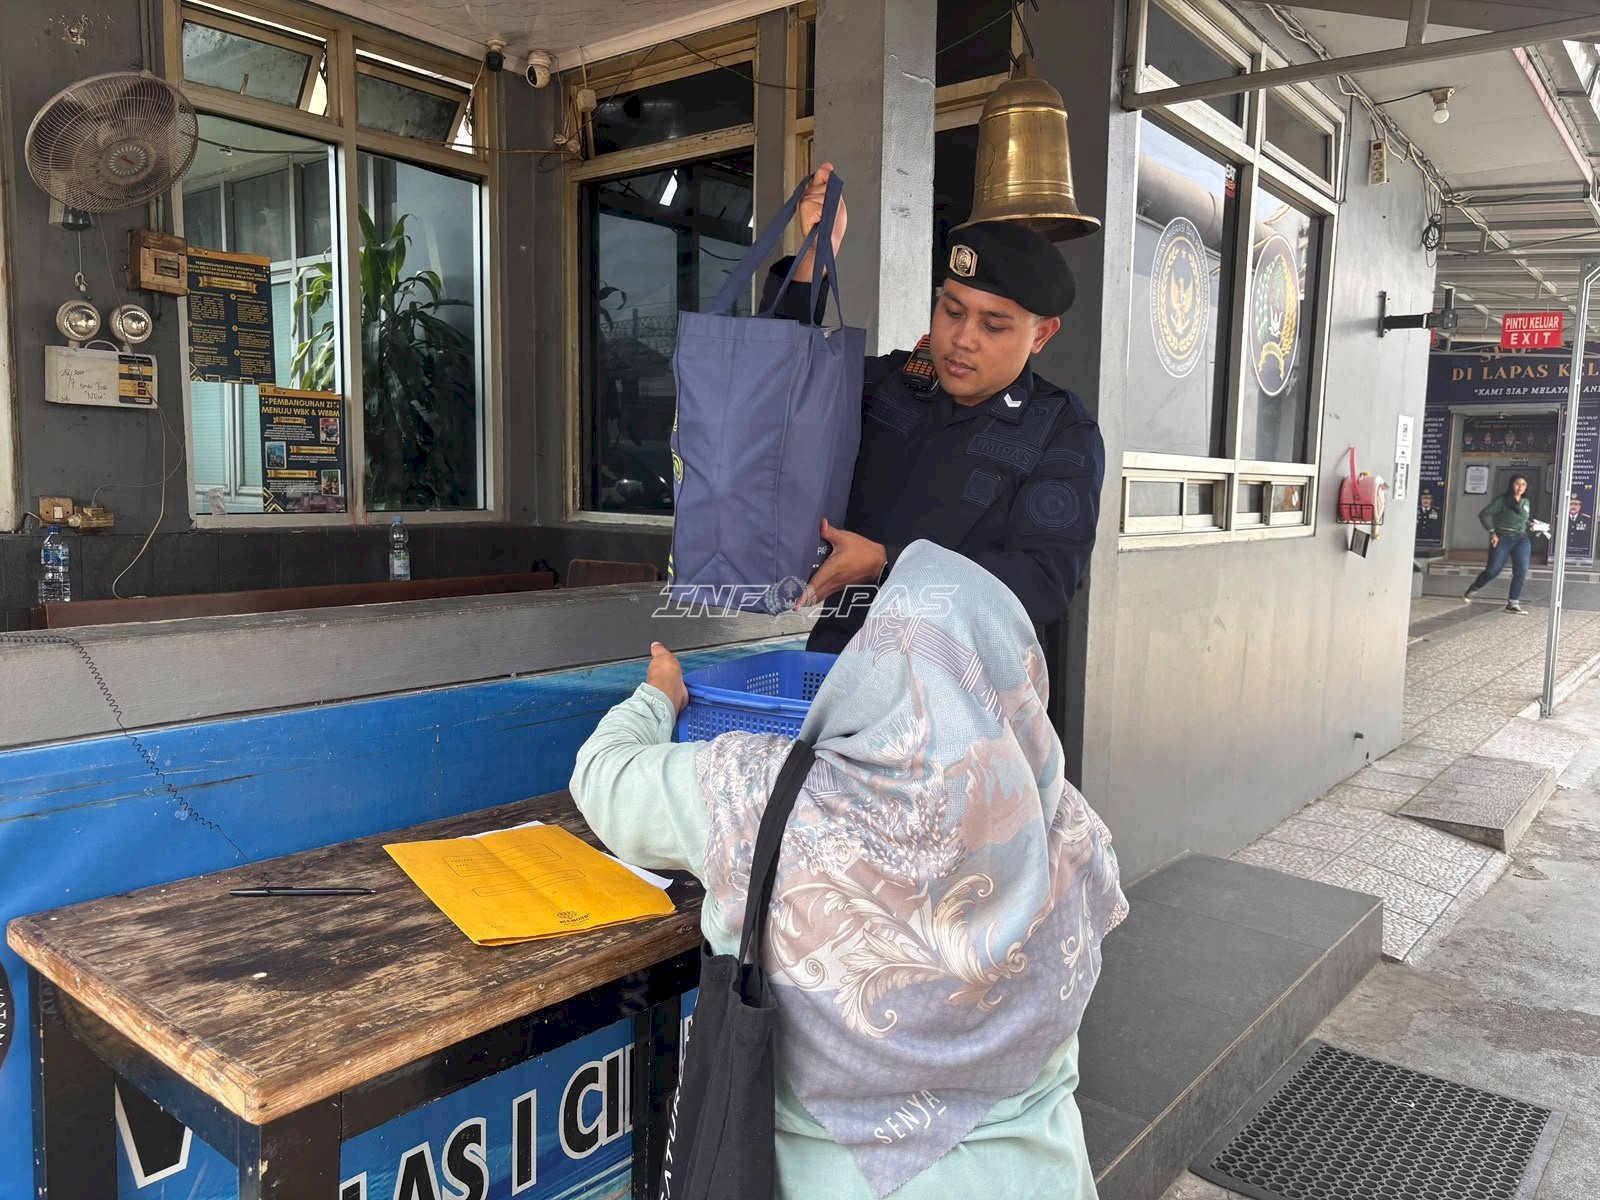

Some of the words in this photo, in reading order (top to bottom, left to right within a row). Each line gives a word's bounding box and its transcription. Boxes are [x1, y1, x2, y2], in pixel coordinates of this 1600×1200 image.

[1505, 317, 1528, 329] PINTU
[1530, 316, 1559, 329] KELUAR
[1510, 332, 1551, 345] EXIT
[1452, 367, 1472, 380] DI
[1482, 364, 1548, 380] LAPAS
[1506, 387, 1529, 395] SIAP
[1531, 386, 1568, 394] MELAYA
[269, 397, 325, 408] PEMBANGUNAN
[261, 406, 292, 415] MENUJU
[293, 408, 310, 416] WBK
[318, 409, 340, 417] WBBM
[874, 1089, 945, 1144] SENYA
